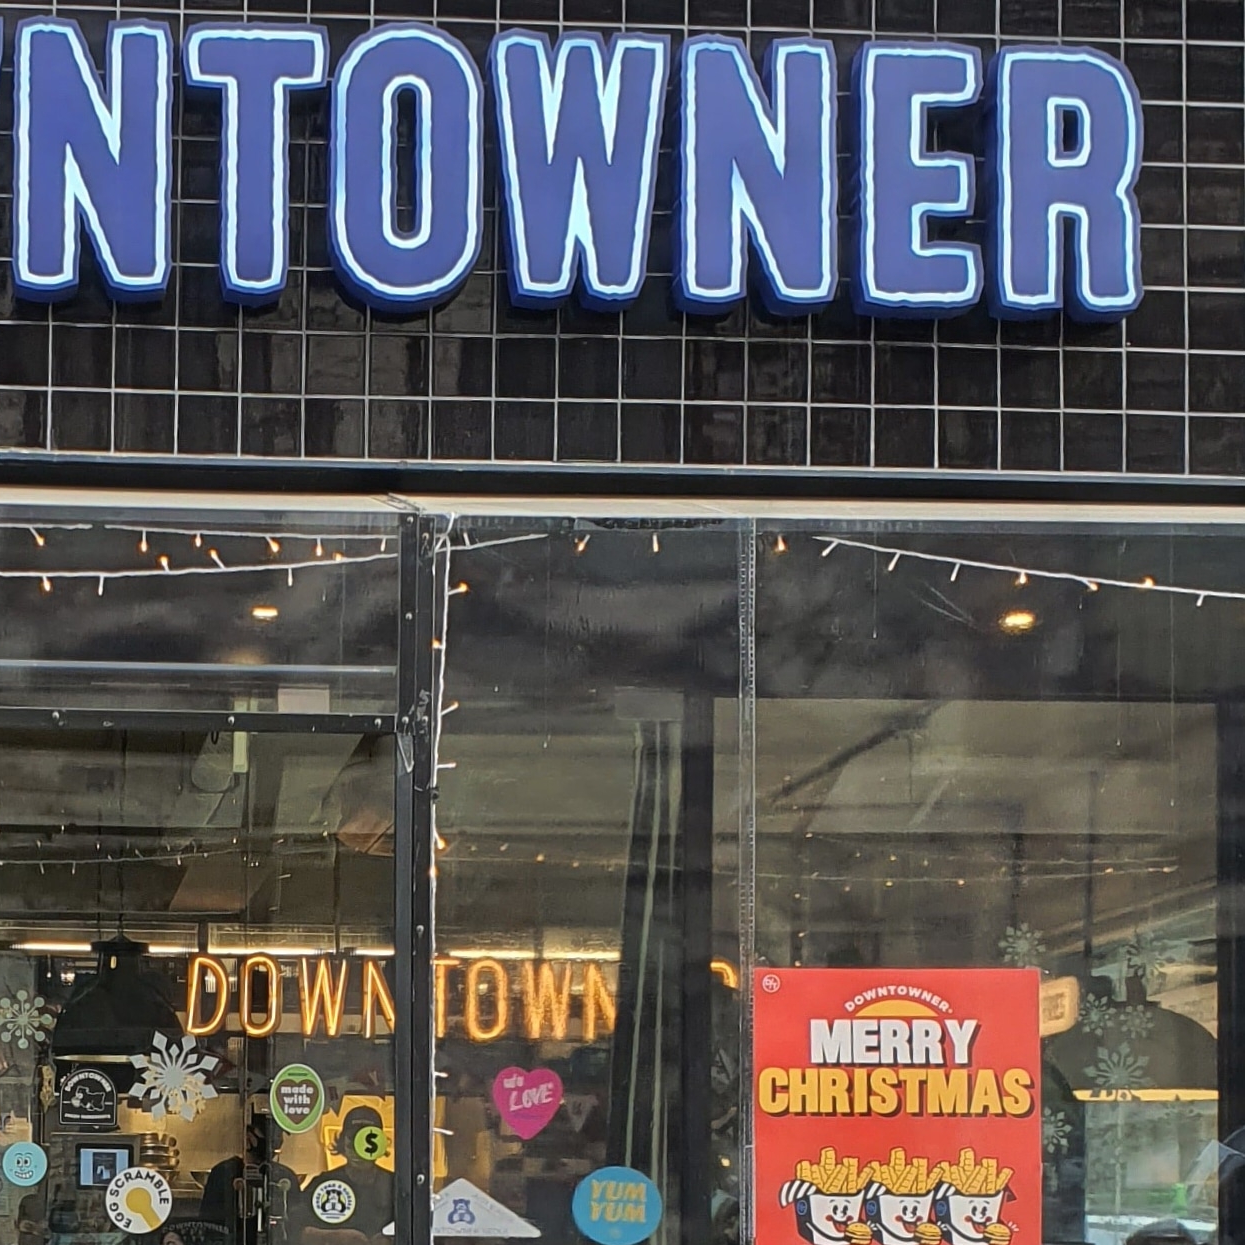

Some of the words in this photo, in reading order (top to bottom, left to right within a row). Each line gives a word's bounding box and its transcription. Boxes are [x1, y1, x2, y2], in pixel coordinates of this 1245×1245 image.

[844, 984, 951, 1013] DOWNTOWNER
[810, 1018, 981, 1066] MERRY
[281, 1084, 314, 1095] made
[283, 1094, 311, 1105] with
[758, 1067, 1034, 1117] CHRISTMAS
[284, 1104, 311, 1115] love
[109, 1169, 170, 1205] SCRAMBLE
[591, 1179, 647, 1202] YUM
[109, 1202, 132, 1229] EGG
[590, 1201, 647, 1223] YUM
